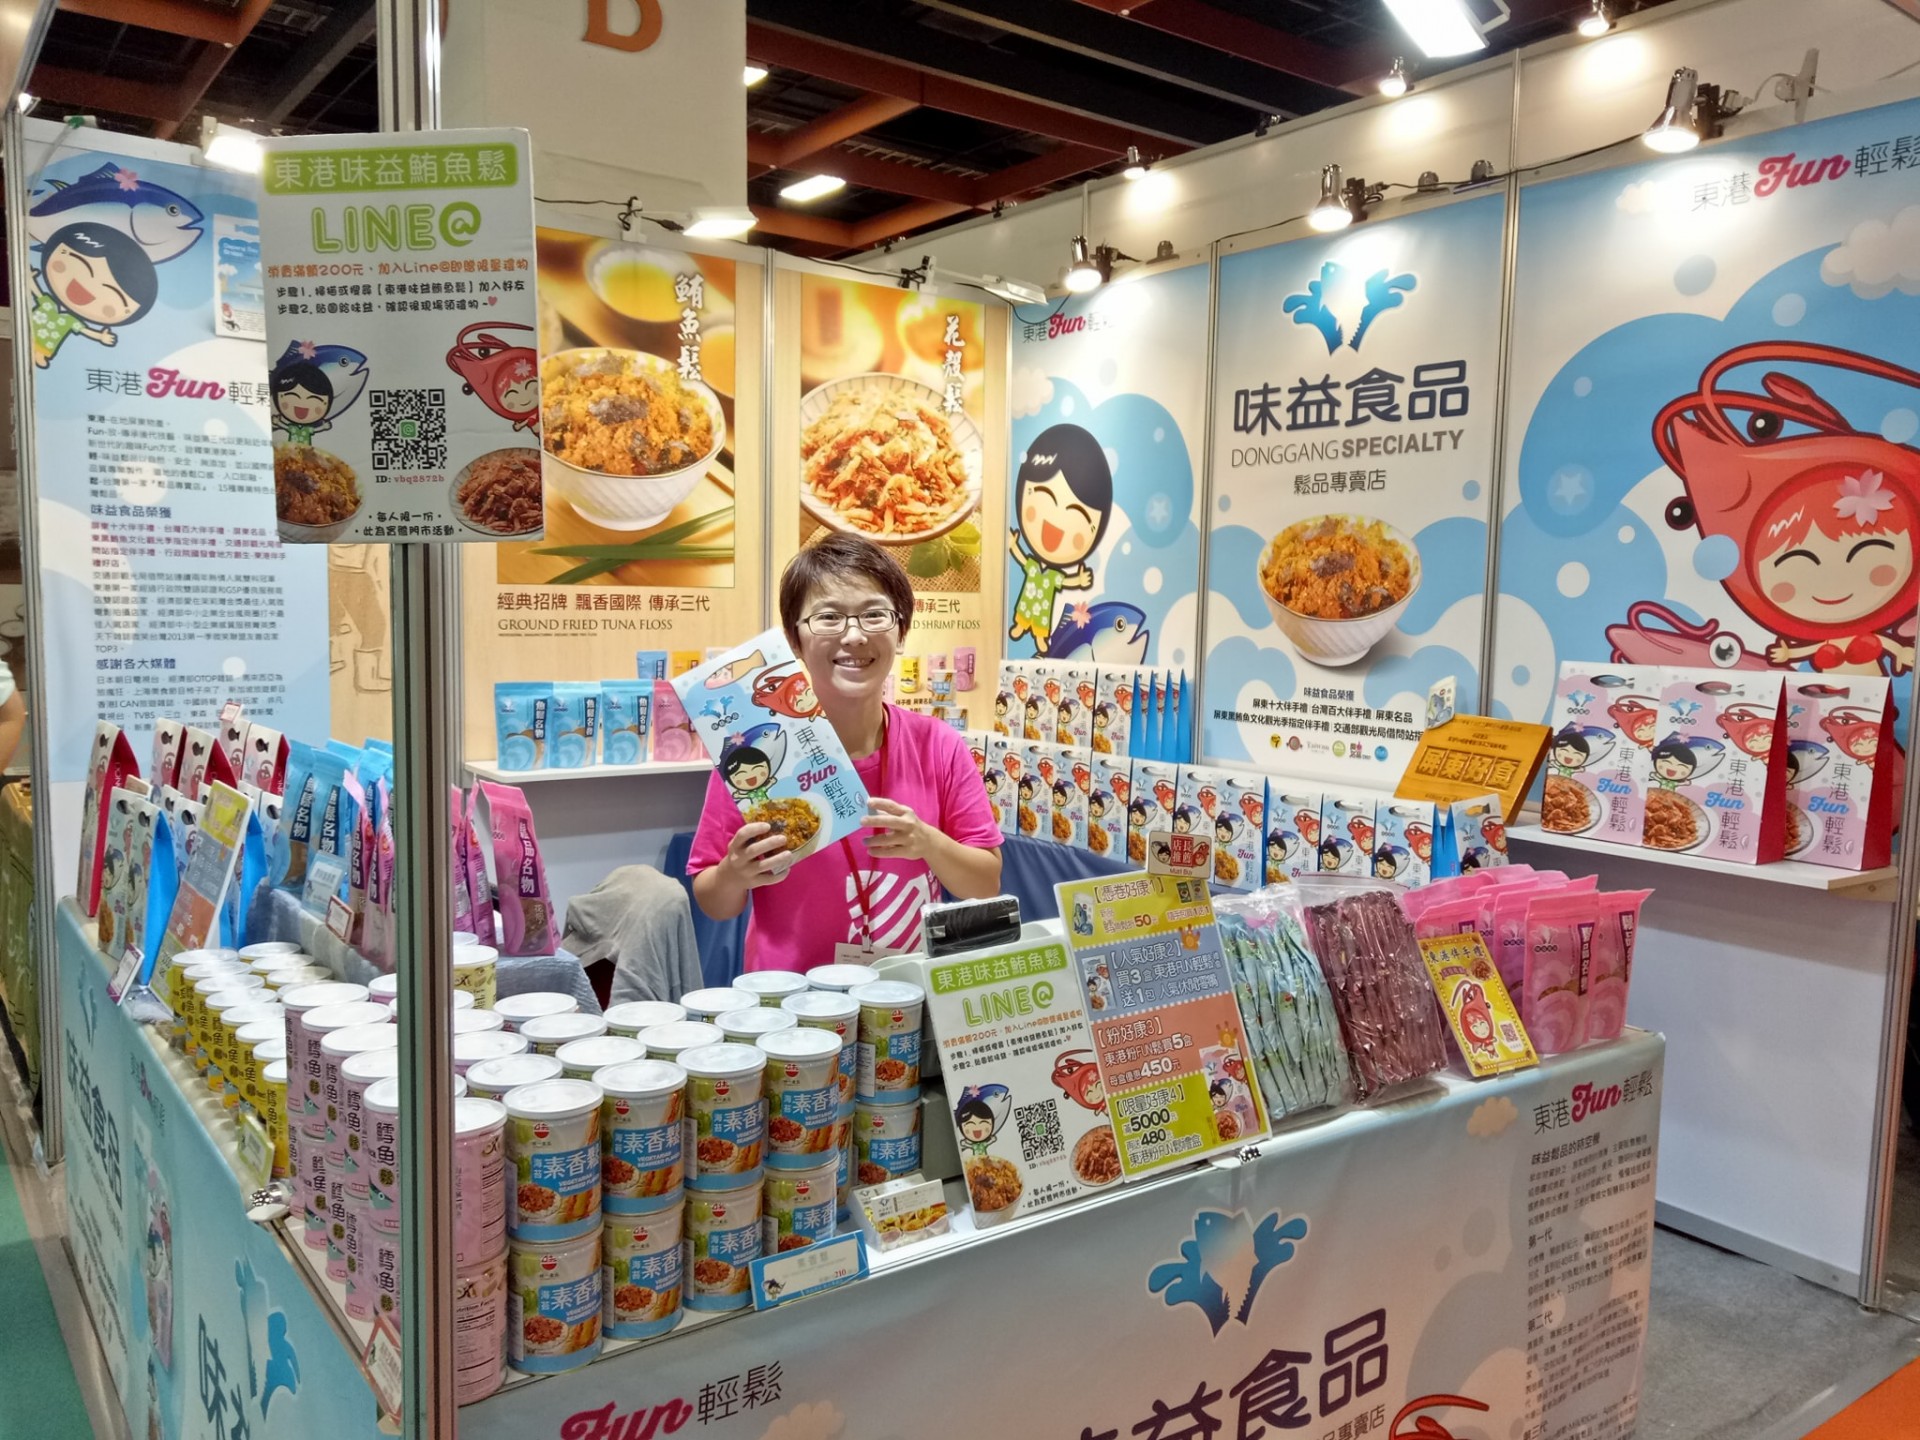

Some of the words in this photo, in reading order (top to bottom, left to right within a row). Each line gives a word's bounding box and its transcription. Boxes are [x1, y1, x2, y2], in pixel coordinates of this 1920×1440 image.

[274, 150, 508, 189] 東港味益鮪魚鬆
[1754, 152, 1852, 198] Fun
[311, 201, 482, 254] LINE@
[673, 274, 704, 381] 鮪魚鬆
[1049, 313, 1086, 339] Fun
[86, 368, 142, 397] 東港
[146, 367, 226, 400] Fun
[1233, 360, 1470, 436] 味益食品
[1231, 439, 1339, 467] DONGGANG
[1341, 429, 1464, 458] SPECIALTY
[1293, 469, 1386, 495] 鬆品專賣店
[91, 504, 172, 518] 味益食品榮獲
[497, 593, 568, 612] 經典招牌
[575, 594, 642, 612] 飄香國際
[648, 595, 711, 613] 傳承三代
[498, 618, 559, 631] GROUND
[563, 618, 598, 631] FRIED
[600, 618, 637, 631] TUNA
[639, 618, 673, 631] FLOSS
[922, 619, 955, 630] SHRIMP
[957, 619, 981, 630] FLOSS
[96, 658, 176, 670] 感謝各大媒體
[1252, 698, 1308, 714] 屏東十大伴手禮
[1311, 703, 1372, 720] 台灣百大伴手禮
[1375, 709, 1413, 724] 屏東名品
[1303, 686, 1355, 702] 味益食品榮獲
[794, 725, 830, 769] 東港
[1614, 747, 1635, 782] 東港
[797, 764, 837, 792] Fun
[1596, 777, 1632, 795] Fun
[1725, 758, 1748, 797] 東港
[1829, 763, 1852, 800] 東港
[823, 777, 857, 819] 輕鬆
[1705, 791, 1745, 810] Fun
[1808, 796, 1850, 815] Fun
[1719, 811, 1740, 849] 輕鬆
[1822, 816, 1845, 856] 輕鬆
[1237, 848, 1255, 860] Fun
[936, 948, 1064, 991] 東港味益鮪魚鬆
[962, 980, 1055, 1028] LINE@
[1533, 1097, 1570, 1135] 東港
[1571, 1082, 1622, 1123] Fun
[1623, 1070, 1653, 1103] 輕鬆
[623, 1122, 681, 1154] 素香鬆
[698, 1360, 784, 1426] 輕鬆
